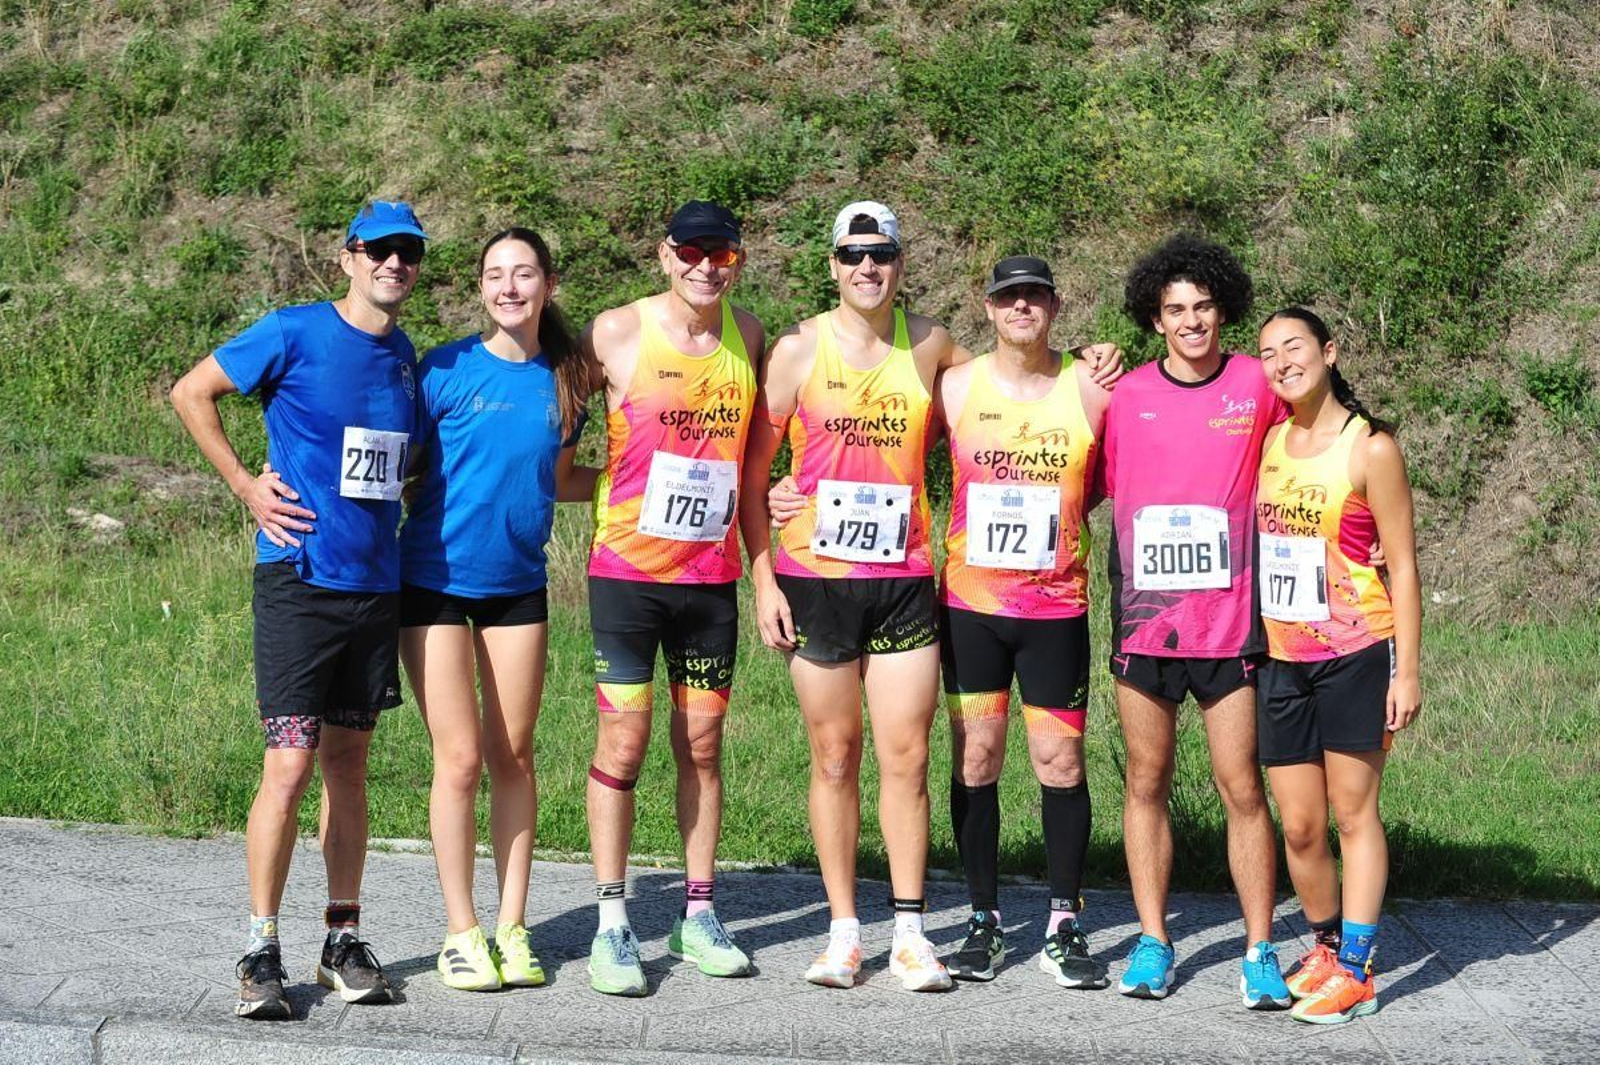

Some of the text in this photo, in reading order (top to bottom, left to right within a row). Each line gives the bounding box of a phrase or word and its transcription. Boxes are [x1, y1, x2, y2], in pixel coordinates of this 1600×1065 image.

[345, 447, 388, 483] 220
[664, 494, 708, 527] 176
[849, 508, 870, 517] JUAN
[836, 519, 879, 550] 179
[987, 522, 1027, 554] 172
[1143, 543, 1211, 575] 3006
[1269, 573, 1296, 606] 177
